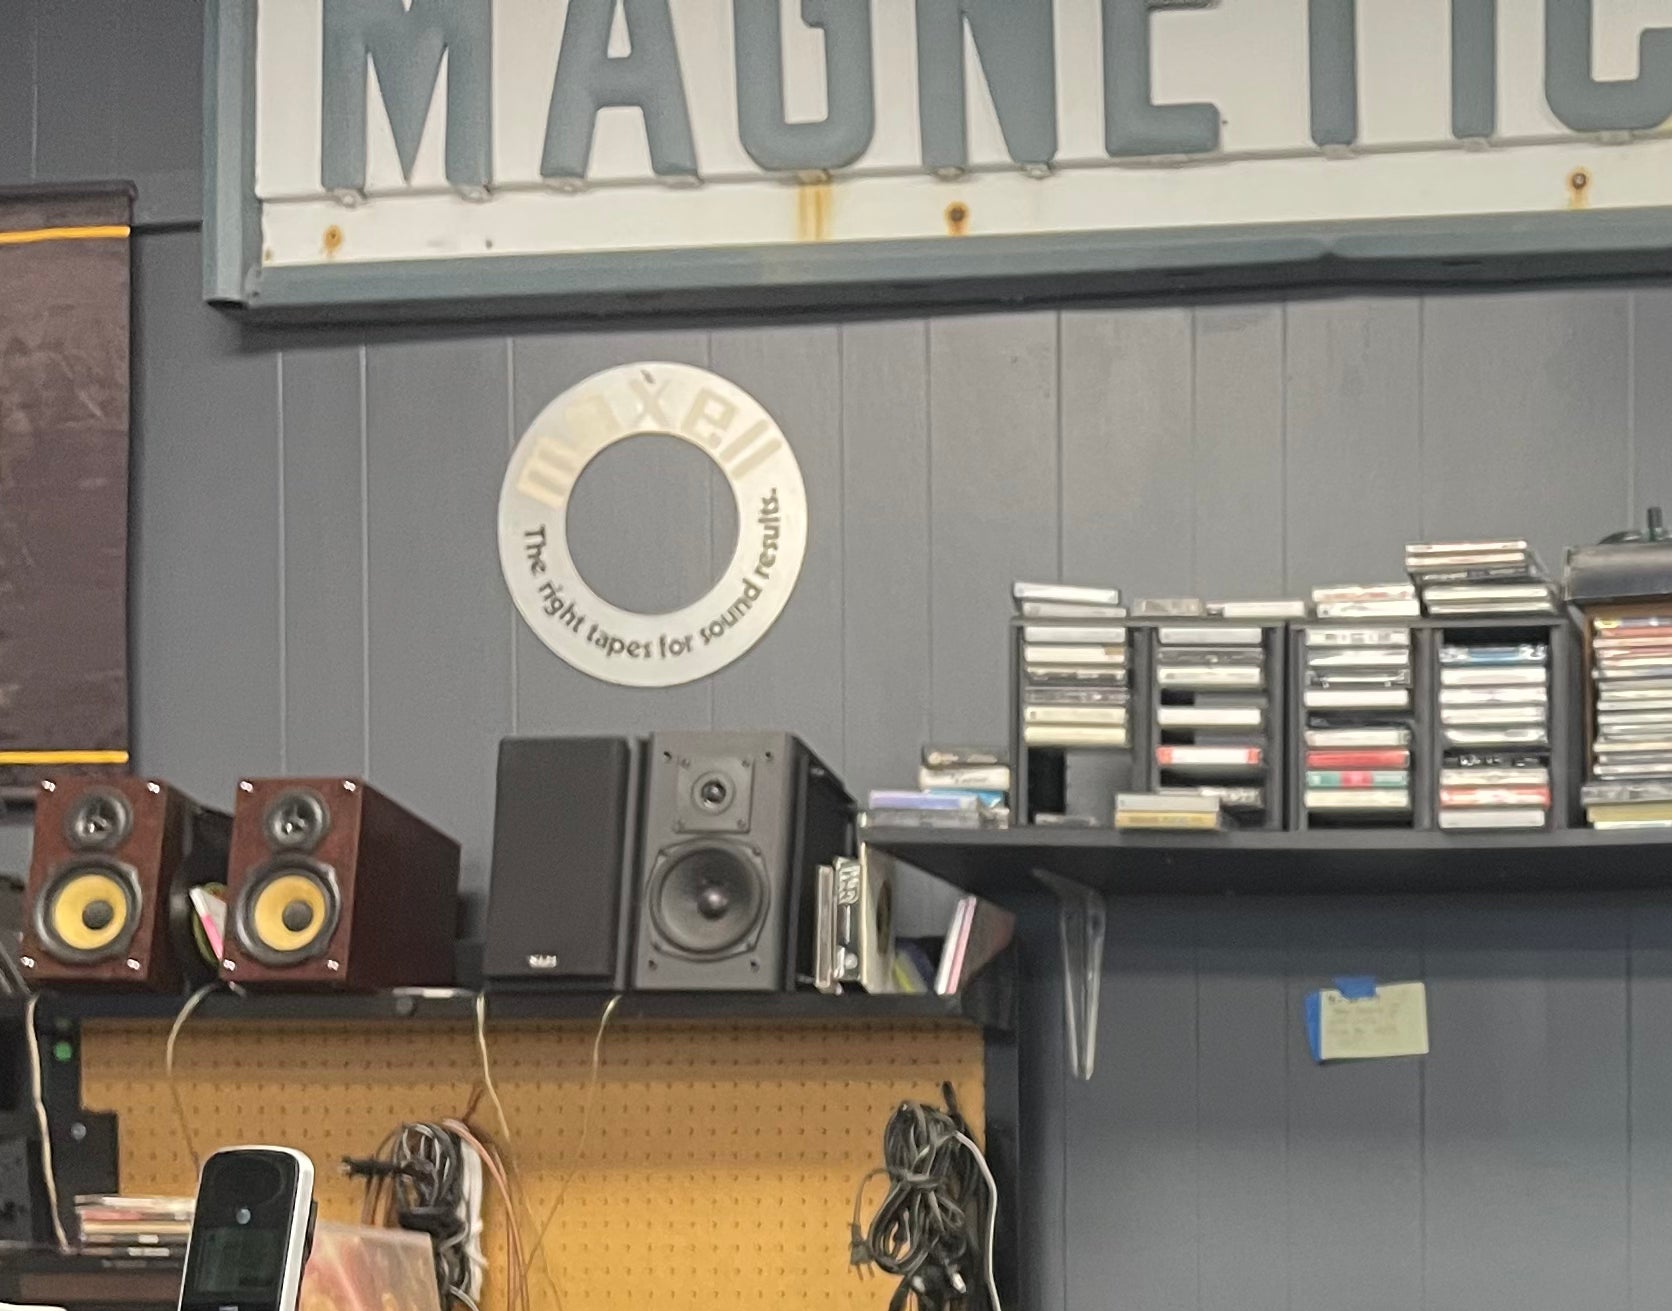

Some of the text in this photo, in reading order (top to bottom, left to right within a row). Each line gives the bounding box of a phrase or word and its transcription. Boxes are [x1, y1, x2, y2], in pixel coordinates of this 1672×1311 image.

[523, 523, 547, 576] The
[538, 581, 588, 633] right
[586, 624, 652, 659] tapes
[659, 633, 693, 660] for
[699, 578, 763, 646] sound
